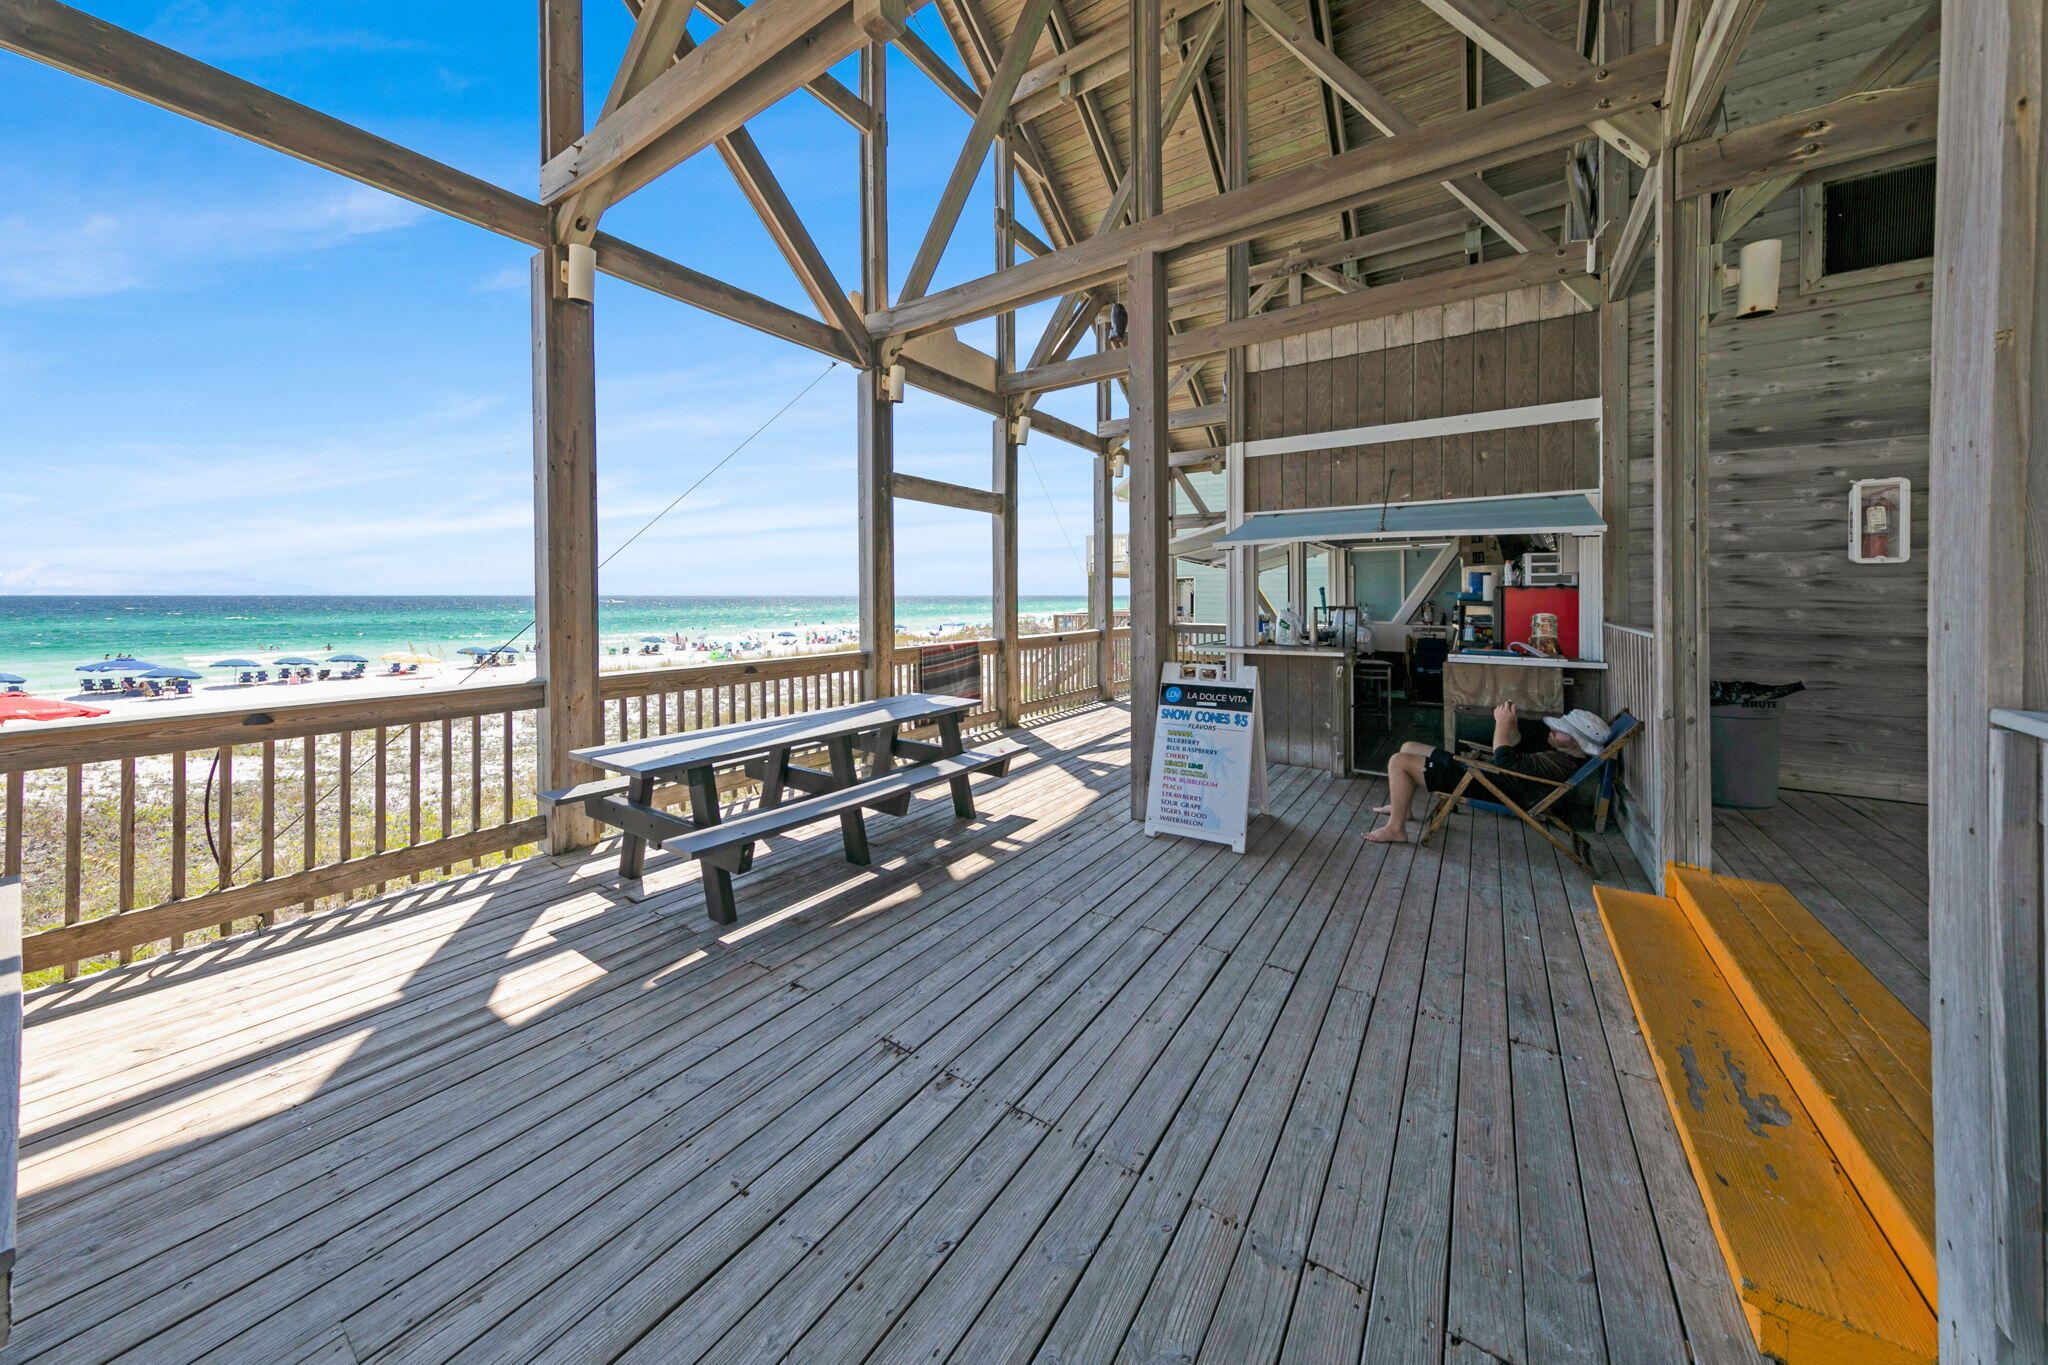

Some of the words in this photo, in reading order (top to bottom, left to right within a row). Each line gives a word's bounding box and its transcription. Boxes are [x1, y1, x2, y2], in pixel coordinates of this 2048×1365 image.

[1187, 692, 1197, 700] LA
[1199, 692, 1227, 702] DOLCE
[1229, 695, 1247, 703] VITA
[1161, 709, 1191, 720] SNOW
[1195, 711, 1230, 724] CONES
[1234, 713, 1248, 727] $5
[1188, 723, 1216, 731] FLAVORS
[1167, 737, 1200, 745] BLUEBERRY
[1182, 747, 1218, 755] RASPBERRY
[1162, 783, 1183, 791] PEACH
[1179, 777, 1218, 787] BUBBLEGUM
[1161, 791, 1202, 801] STRAWBERRY
[1181, 802, 1201, 810] GRAPE
[1161, 807, 1182, 815] TIGERS
[1184, 811, 1207, 819] BLOOD
[1160, 815, 1203, 827] WATERMELON
